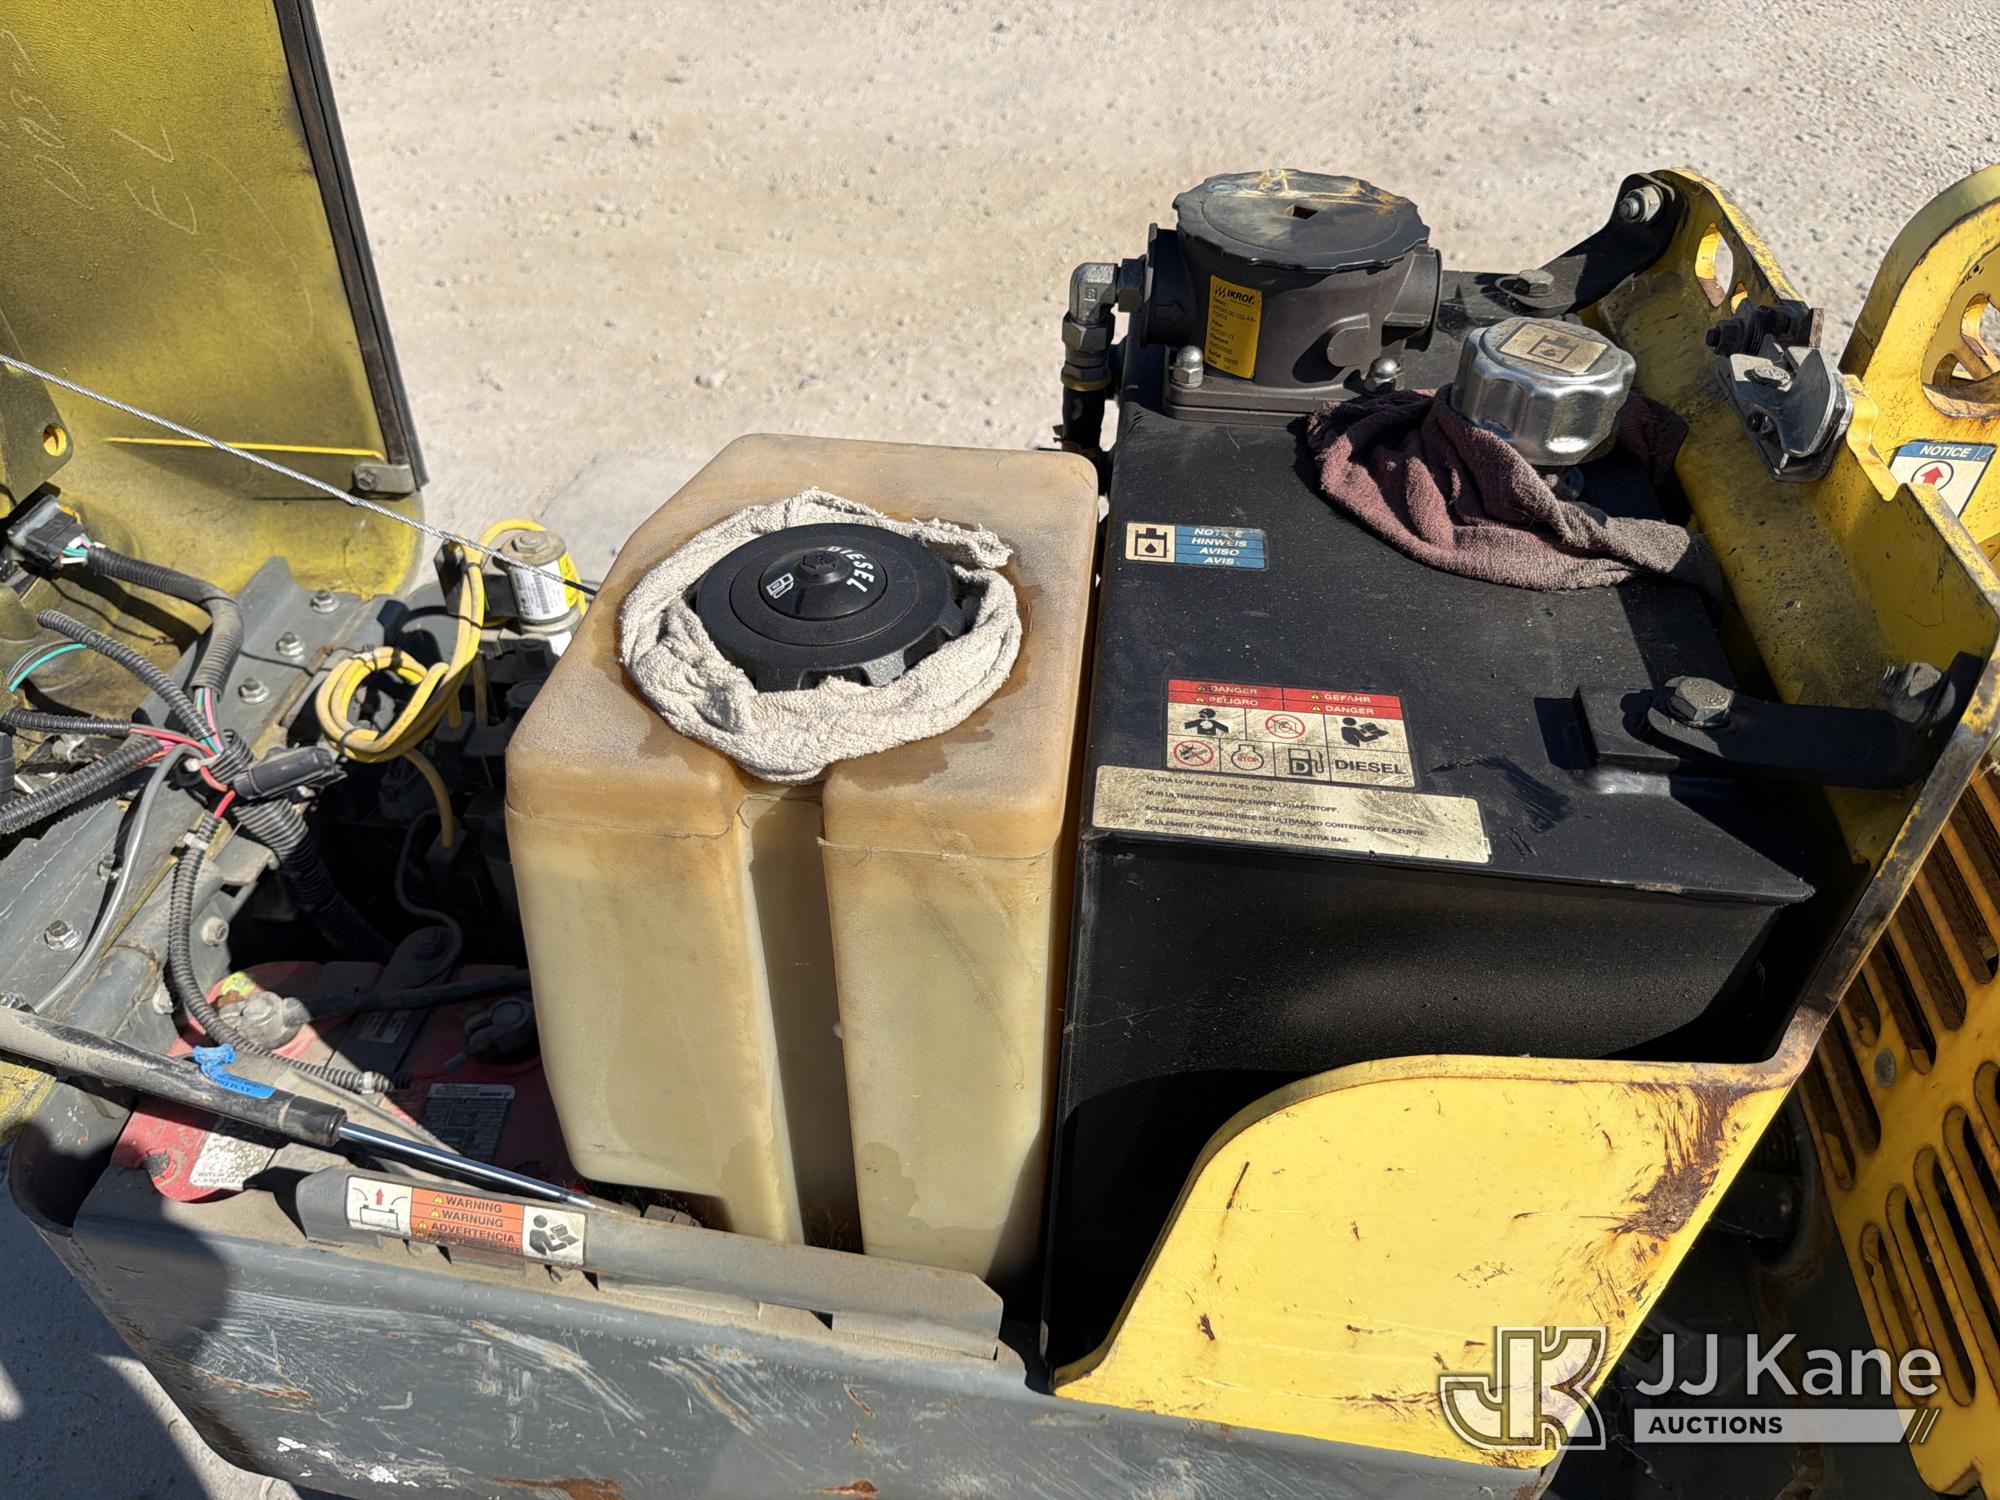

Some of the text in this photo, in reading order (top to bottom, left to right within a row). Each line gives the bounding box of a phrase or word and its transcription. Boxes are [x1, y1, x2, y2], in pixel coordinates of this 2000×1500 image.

[1919, 445, 1972, 457] NOTICE
[1194, 528, 1243, 537] NOTE
[1191, 537, 1248, 547] HINWEIS
[1199, 547, 1240, 556] AVISO
[1204, 557, 1234, 565] AVIS
[827, 546, 875, 593] DIESEL
[1209, 685, 1258, 695] DANGER
[1208, 696, 1258, 706] PELIGRO
[1324, 694, 1372, 703] GEFAHR
[1325, 705, 1375, 715] DANGER
[1236, 754, 1259, 763] STOP
[1335, 759, 1407, 775] DIESEL
[1146, 776, 1173, 784] ULTRA
[1195, 780, 1228, 788] SULFUR
[446, 1196, 503, 1213] WARNING
[442, 1210, 504, 1228] WARNUNG
[431, 1222, 515, 1243] ADVERTENCIA
